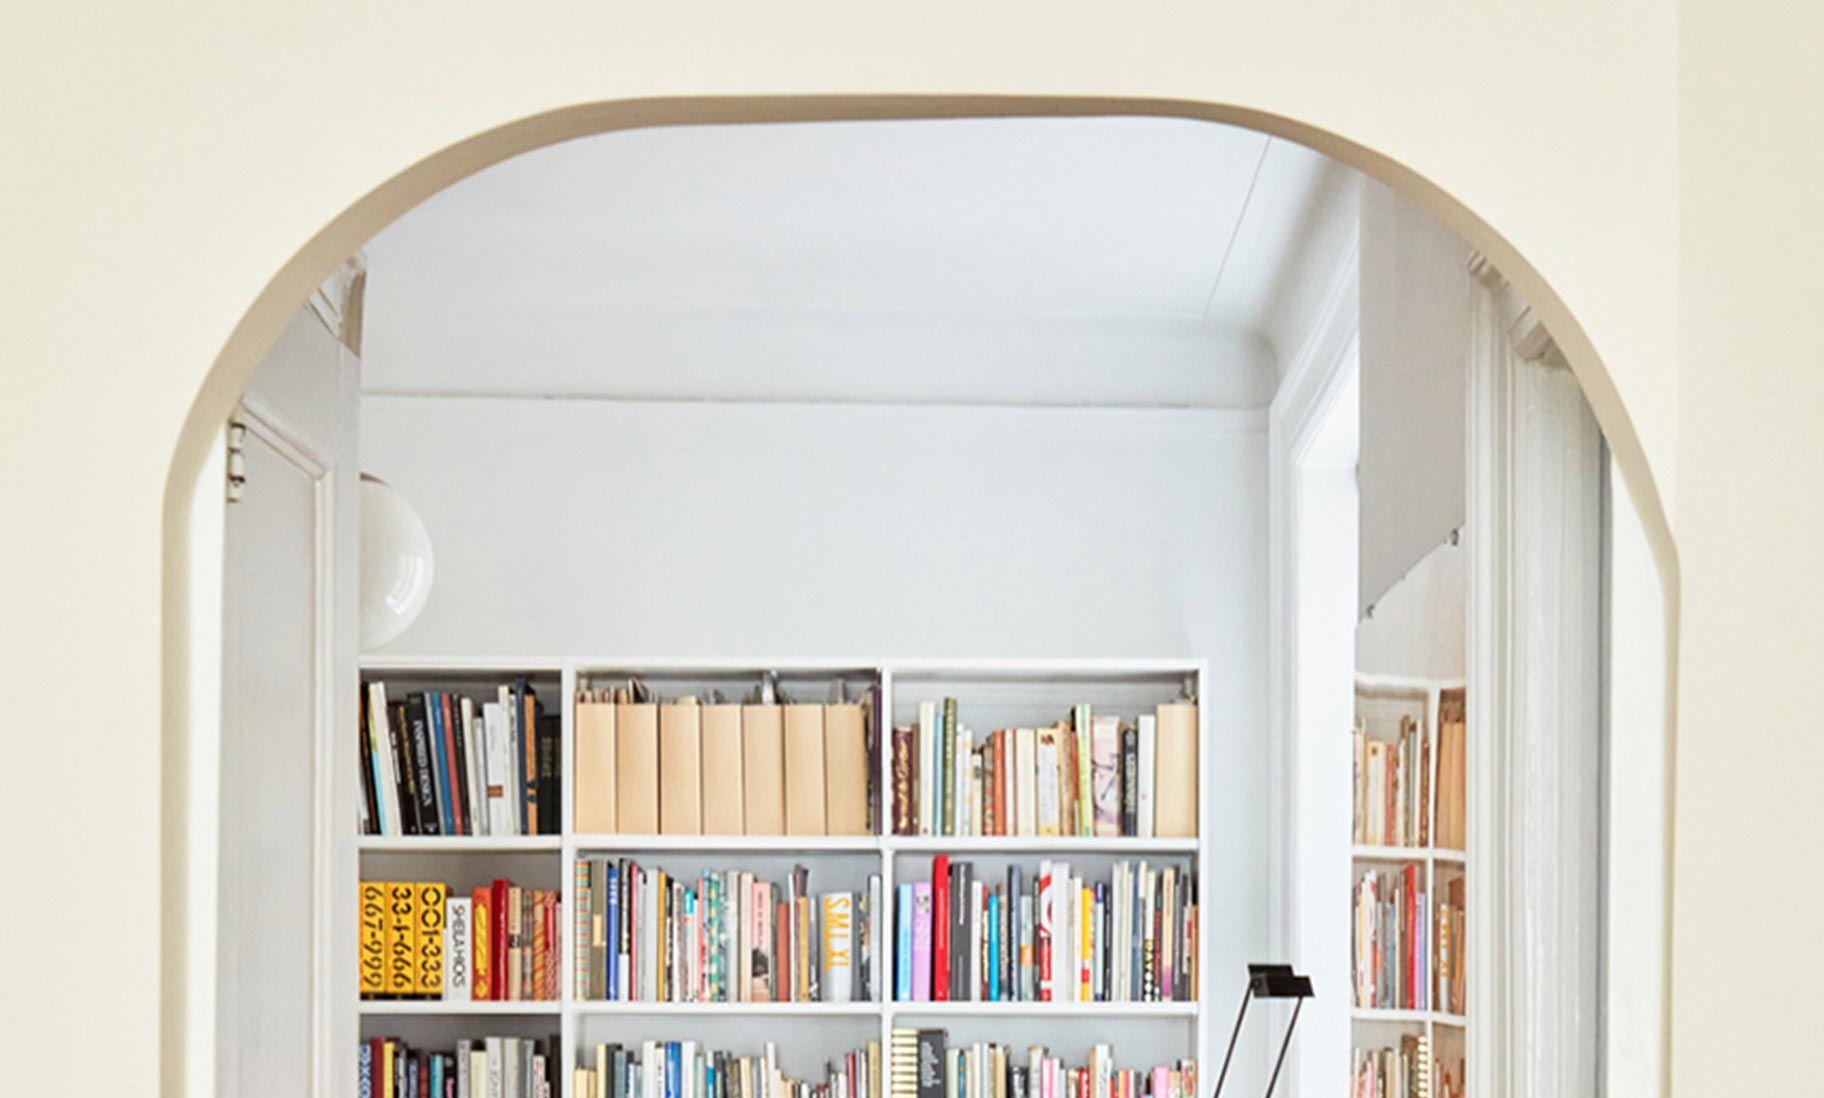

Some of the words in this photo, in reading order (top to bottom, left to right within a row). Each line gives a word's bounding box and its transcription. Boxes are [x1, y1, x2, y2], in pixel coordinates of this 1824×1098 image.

[363, 886, 383, 987] 667-999
[391, 886, 412, 987] 334-666
[421, 887, 441, 987] 001-333
